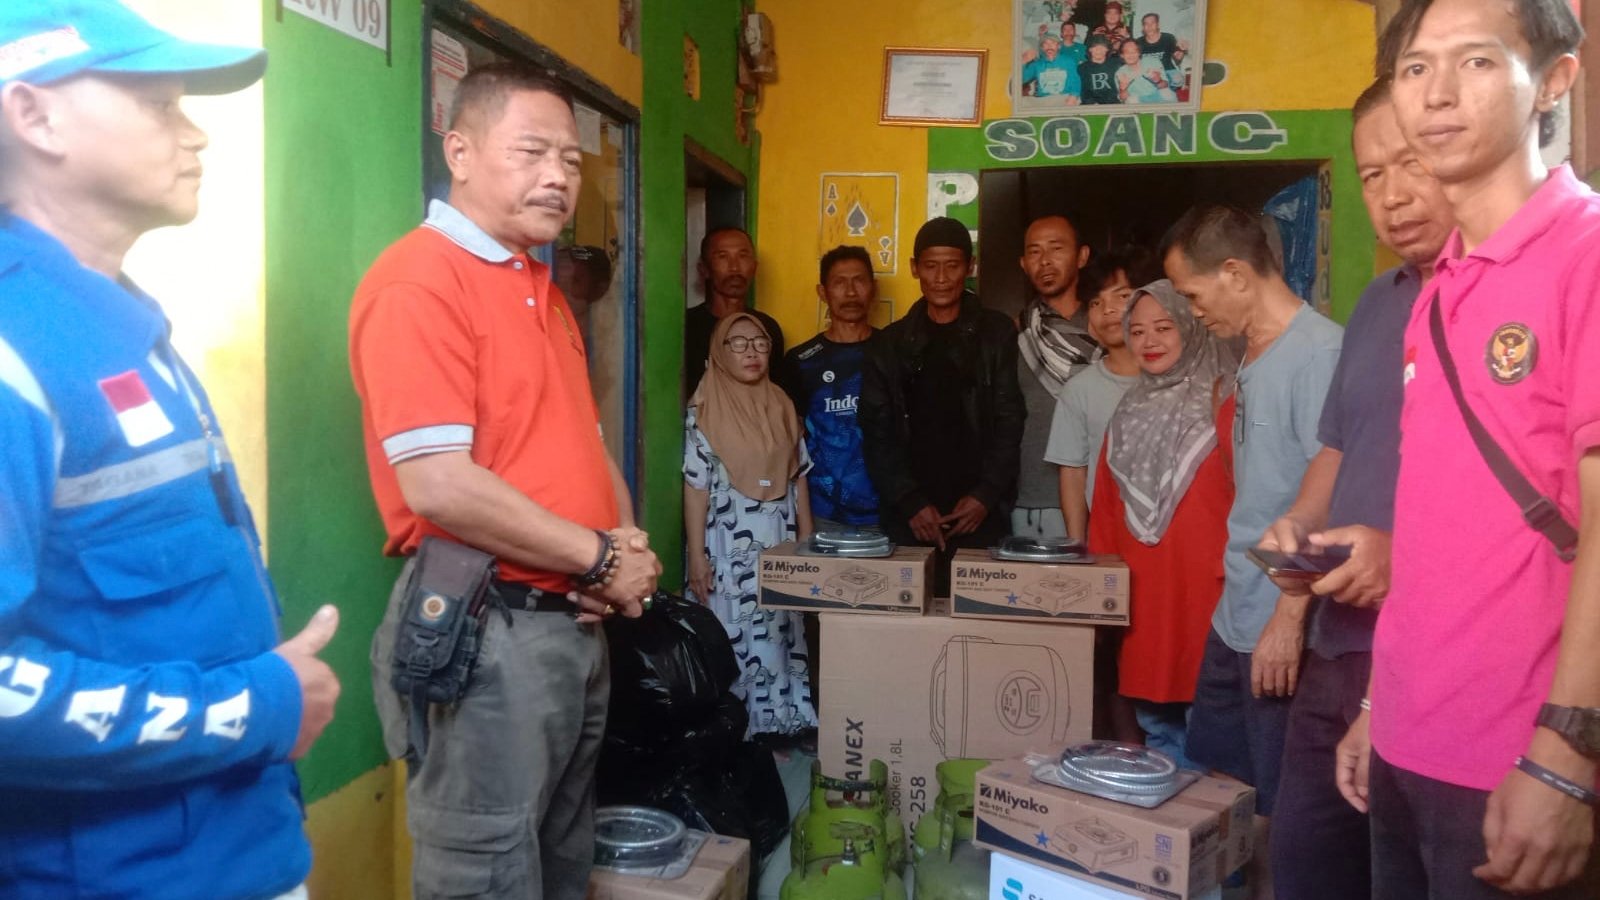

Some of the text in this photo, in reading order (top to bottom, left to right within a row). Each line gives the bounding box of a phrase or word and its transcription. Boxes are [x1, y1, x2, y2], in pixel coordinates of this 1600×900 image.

[353, 0, 381, 38] 09
[775, 561, 820, 574] Miyako
[969, 567, 1017, 582] Miyako
[845, 717, 863, 800] ANEX
[993, 787, 1049, 815] Miyako
